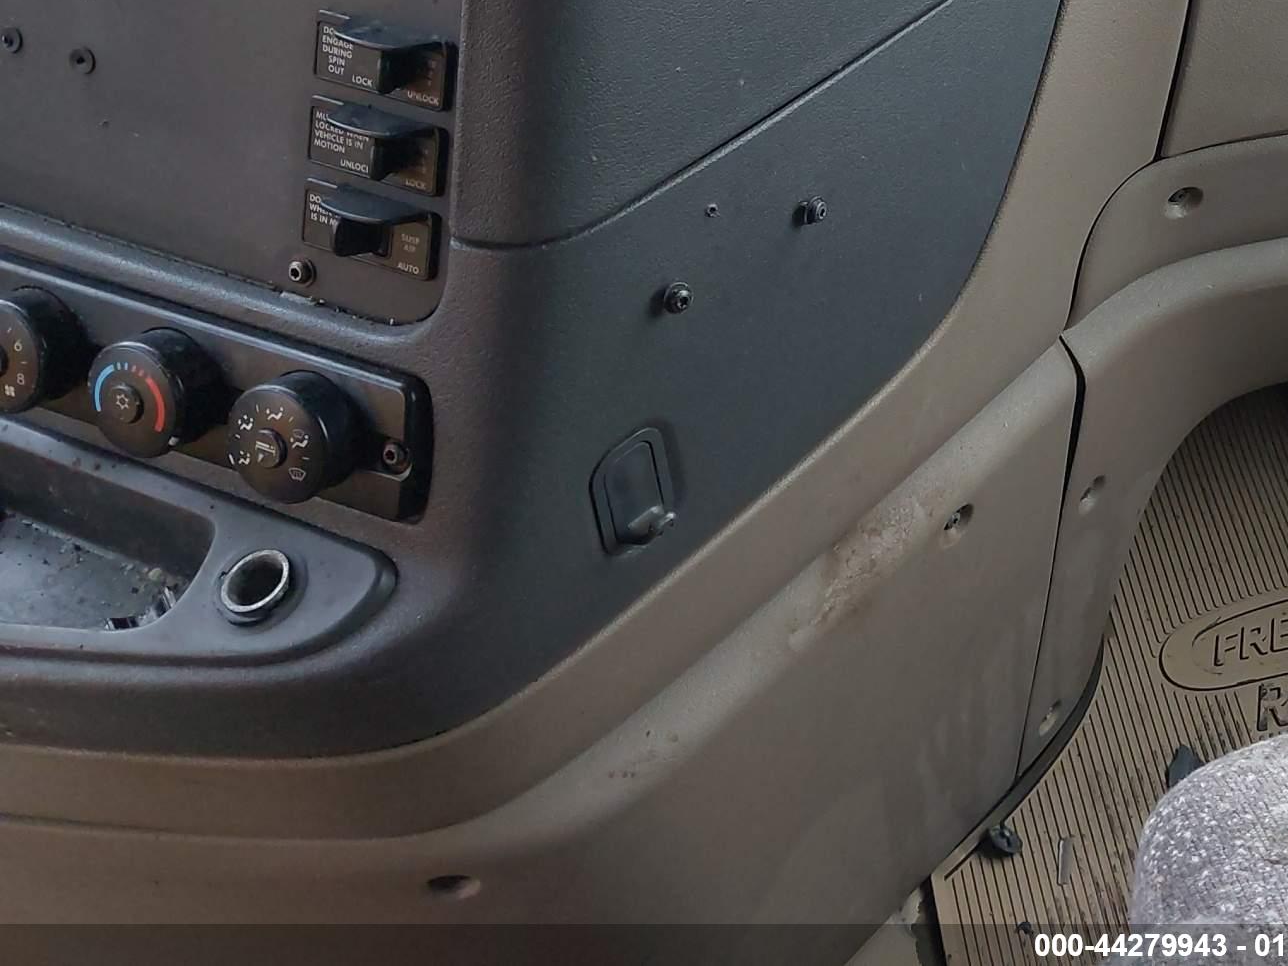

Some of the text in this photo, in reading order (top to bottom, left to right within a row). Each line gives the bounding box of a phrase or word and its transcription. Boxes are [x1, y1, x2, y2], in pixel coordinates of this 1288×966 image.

[322, 35, 354, 50] ENGAGE
[322, 44, 352, 59] DURING
[328, 55, 345, 66] SPIN
[328, 65, 344, 75] OUT
[352, 74, 373, 87] LOCK
[407, 90, 439, 106] UNLOCK
[314, 129, 364, 150] VEHICLE IS IN
[314, 138, 345, 154] MOTION
[310, 212, 318, 221] IS
[319, 214, 328, 224] IN
[397, 261, 419, 274] AUTO
[14, 339, 23, 352] 6
[16, 373, 25, 385] 8
